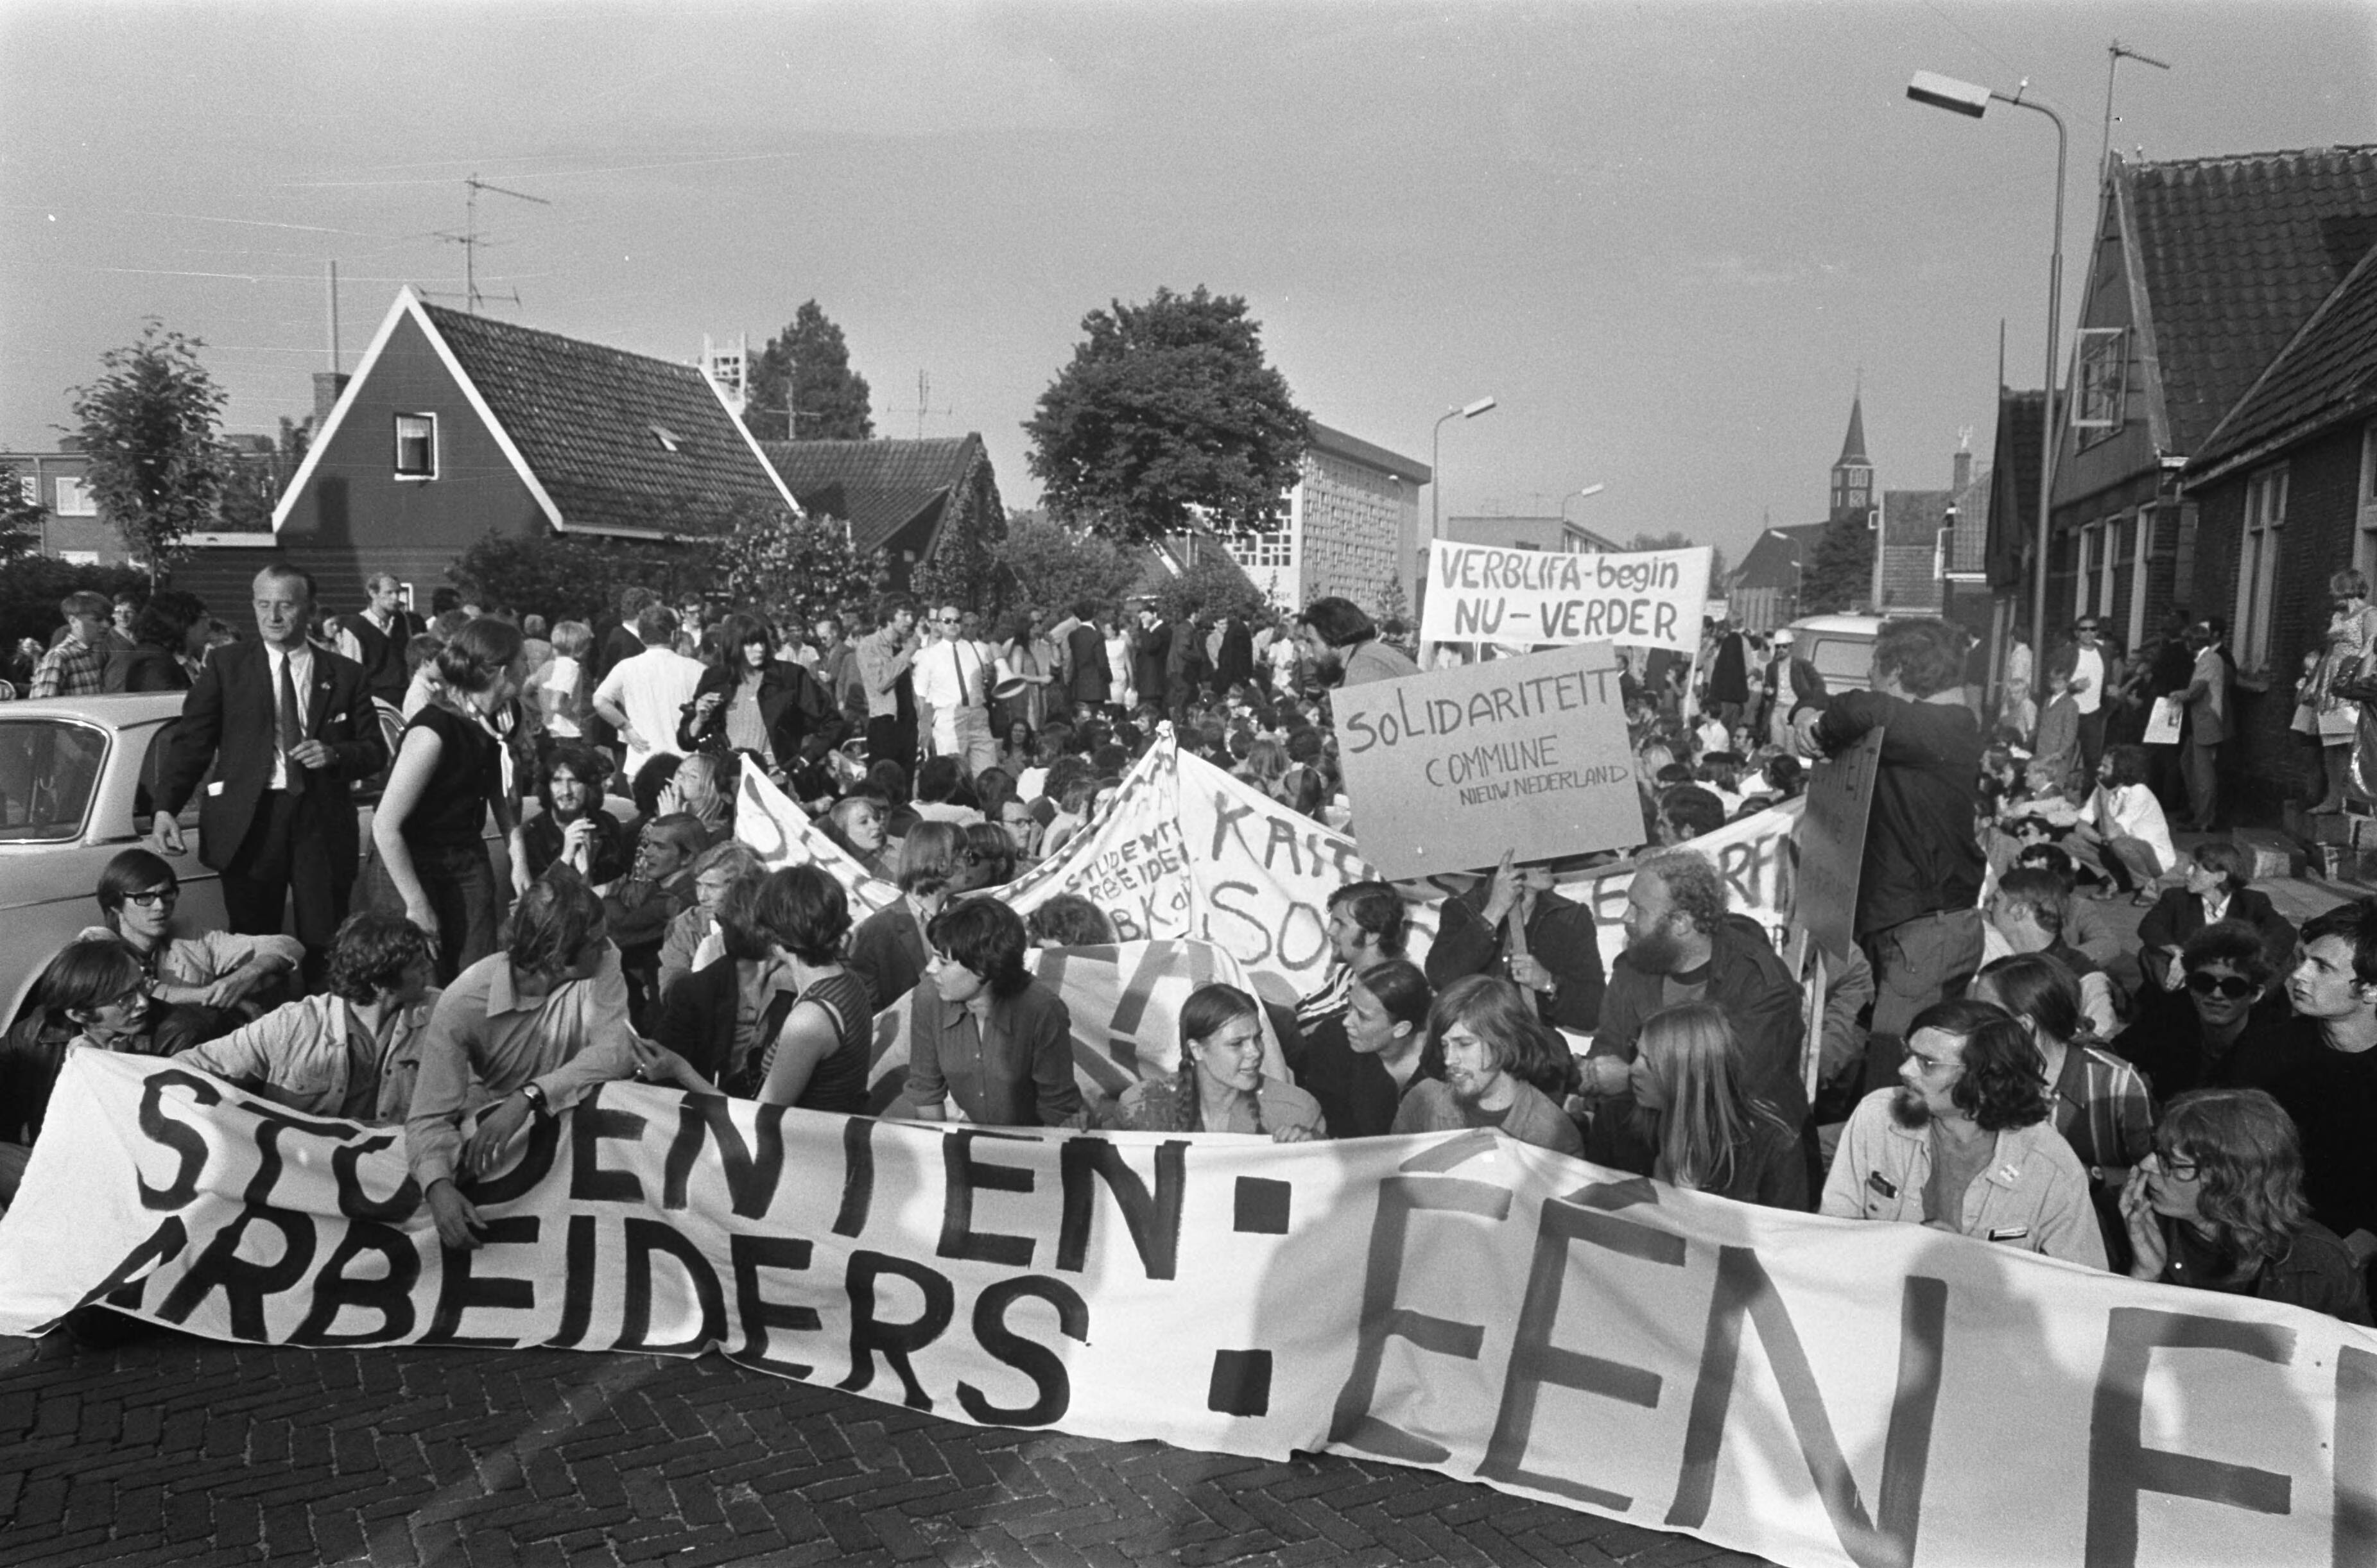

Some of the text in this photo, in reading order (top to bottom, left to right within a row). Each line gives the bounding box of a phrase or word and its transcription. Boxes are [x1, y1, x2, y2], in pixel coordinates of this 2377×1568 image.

[1441, 547, 1679, 592] VERBLIFA-begin
[1346, 667, 1618, 754] SOLIDARITEIT
[1425, 735, 1559, 787] COMMUNE
[1513, 764, 1629, 798] NEDERLAND
[1459, 780, 1510, 806] NIEUW
[1065, 816, 1182, 893] STUDENT
[26, 1214, 1089, 1427] ARBEIDERS
